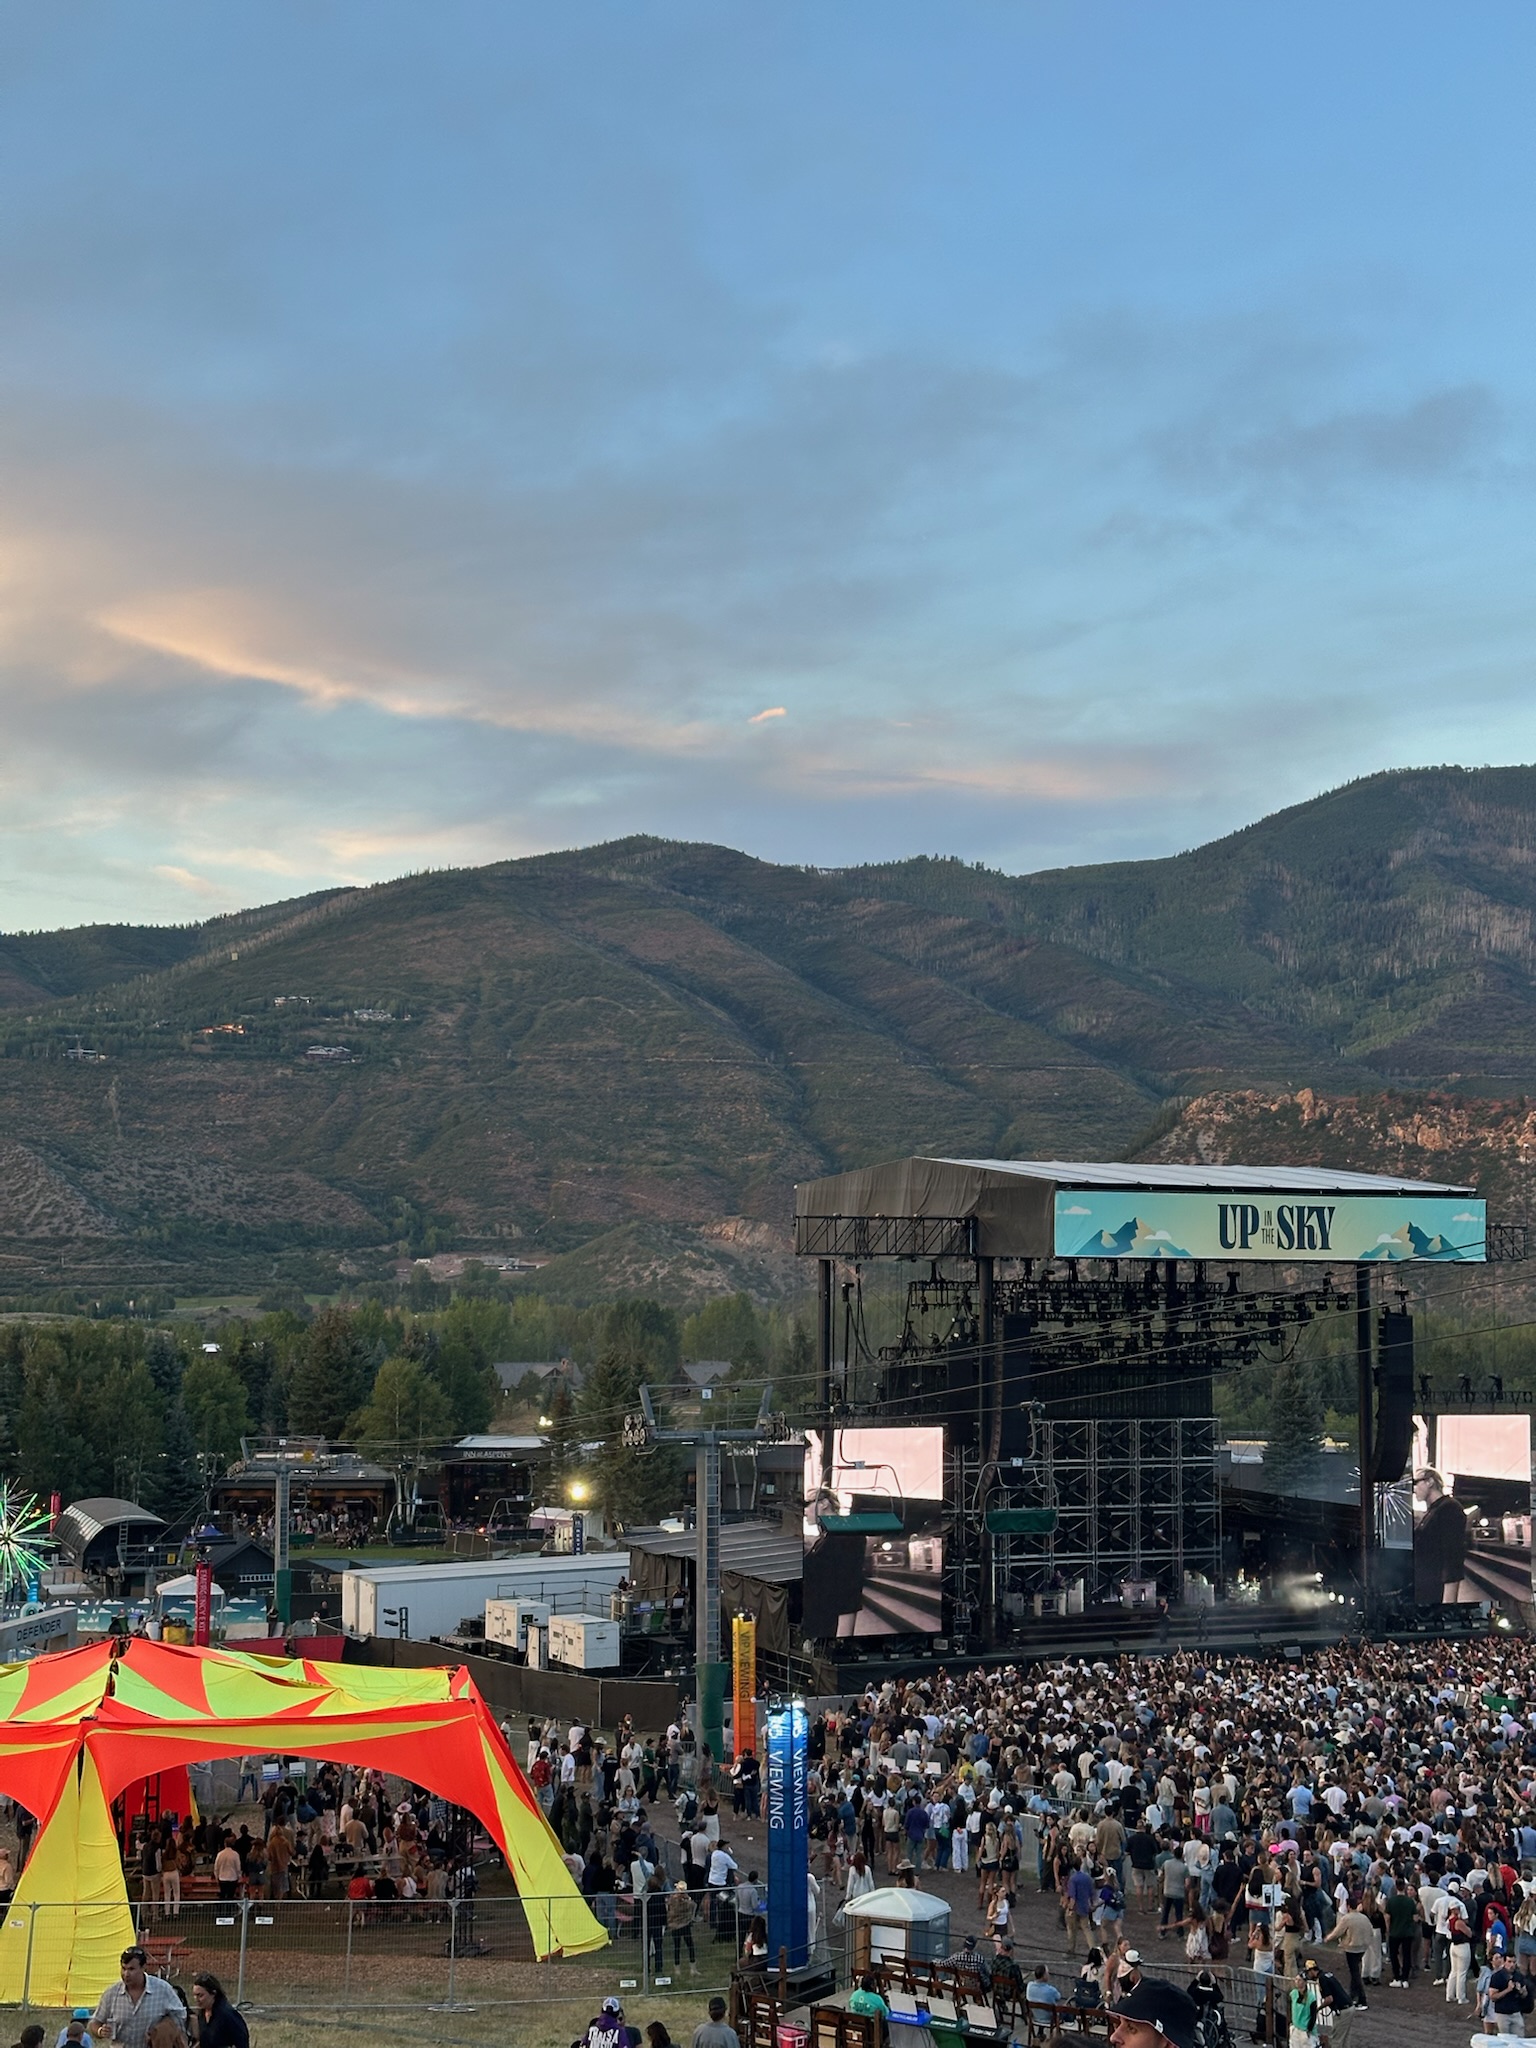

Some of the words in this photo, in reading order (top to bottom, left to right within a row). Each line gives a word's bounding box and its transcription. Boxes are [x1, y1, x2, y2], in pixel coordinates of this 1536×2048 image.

[1218, 1204, 1259, 1249] UP
[1264, 1210, 1273, 1226] IN
[1277, 1205, 1336, 1250] SKY
[1261, 1228, 1275, 1244] THE
[199, 1569, 207, 1615] EMERGENCY
[17, 1619, 62, 1641] DEFENDER
[198, 1616, 206, 1632] EXIT
[740, 1631, 750, 1648] VIP
[769, 1750, 784, 1829] VIEWING
[793, 1748, 804, 1829] VIEWING
